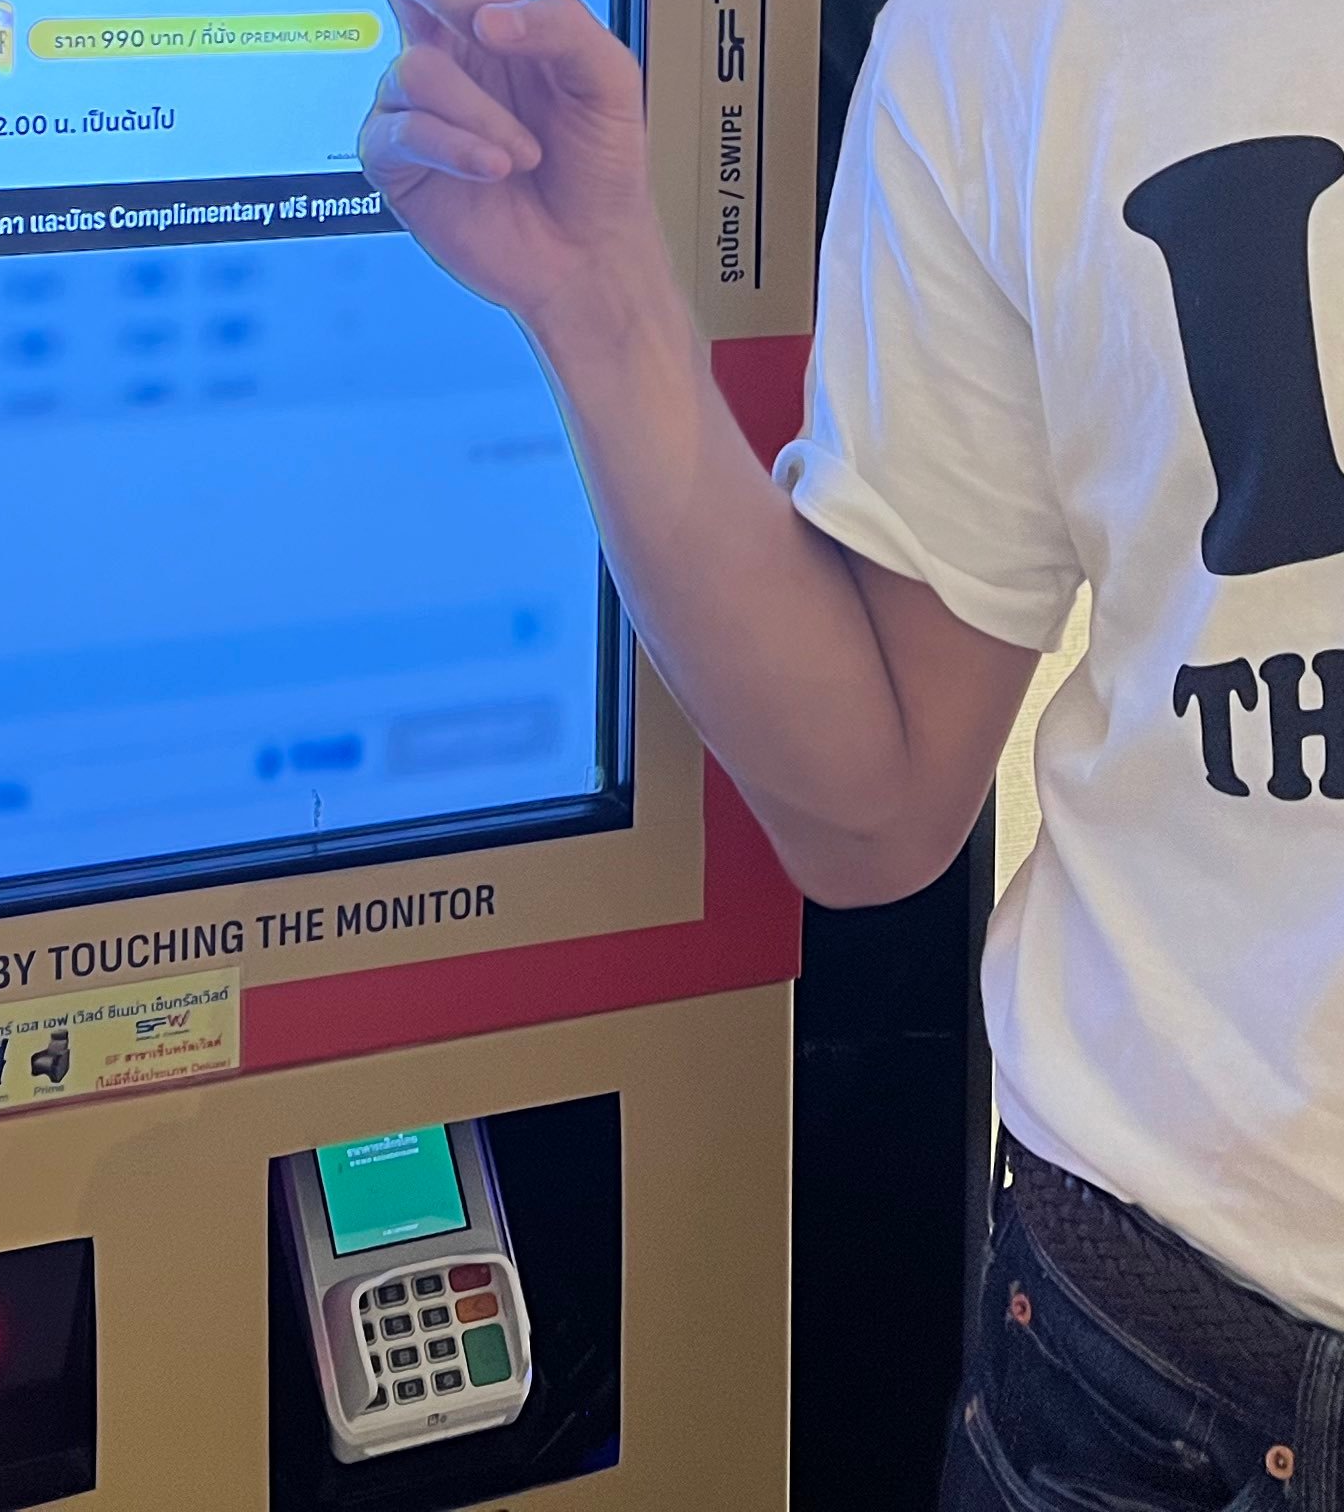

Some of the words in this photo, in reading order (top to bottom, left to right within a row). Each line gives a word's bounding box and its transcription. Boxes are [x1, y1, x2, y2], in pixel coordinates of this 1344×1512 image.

[54, 34, 97, 50] ราคา
[101, 29, 145, 49] 990
[150, 30, 184, 48] บาท
[201, 22, 236, 47] ที่นั่ง
[240, 29, 312, 46] (PREMIUM,
[314, 27, 361, 43] PRIME)
[55, 117, 77, 134] น.
[83, 106, 175, 133] เป็นต้นไป
[720, 103, 743, 183] SWIPE
[30, 207, 105, 234] และบัตร
[109, 198, 275, 231] Complimentary
[279, 194, 307, 220] ฟรี
[311, 190, 382, 224] ทุกกรณี
[720, 205, 745, 284] รูดบัตร
[47, 919, 244, 980] TOUCHING
[256, 906, 325, 950] THE
[337, 884, 497, 939] MONITOR
[17, 1017, 40, 1034] เอส
[42, 1010, 69, 1030] เอฟ
[73, 1005, 104, 1026] เวิลด์
[151, 985, 229, 1014] เซ็นทรัลเวิลด์
